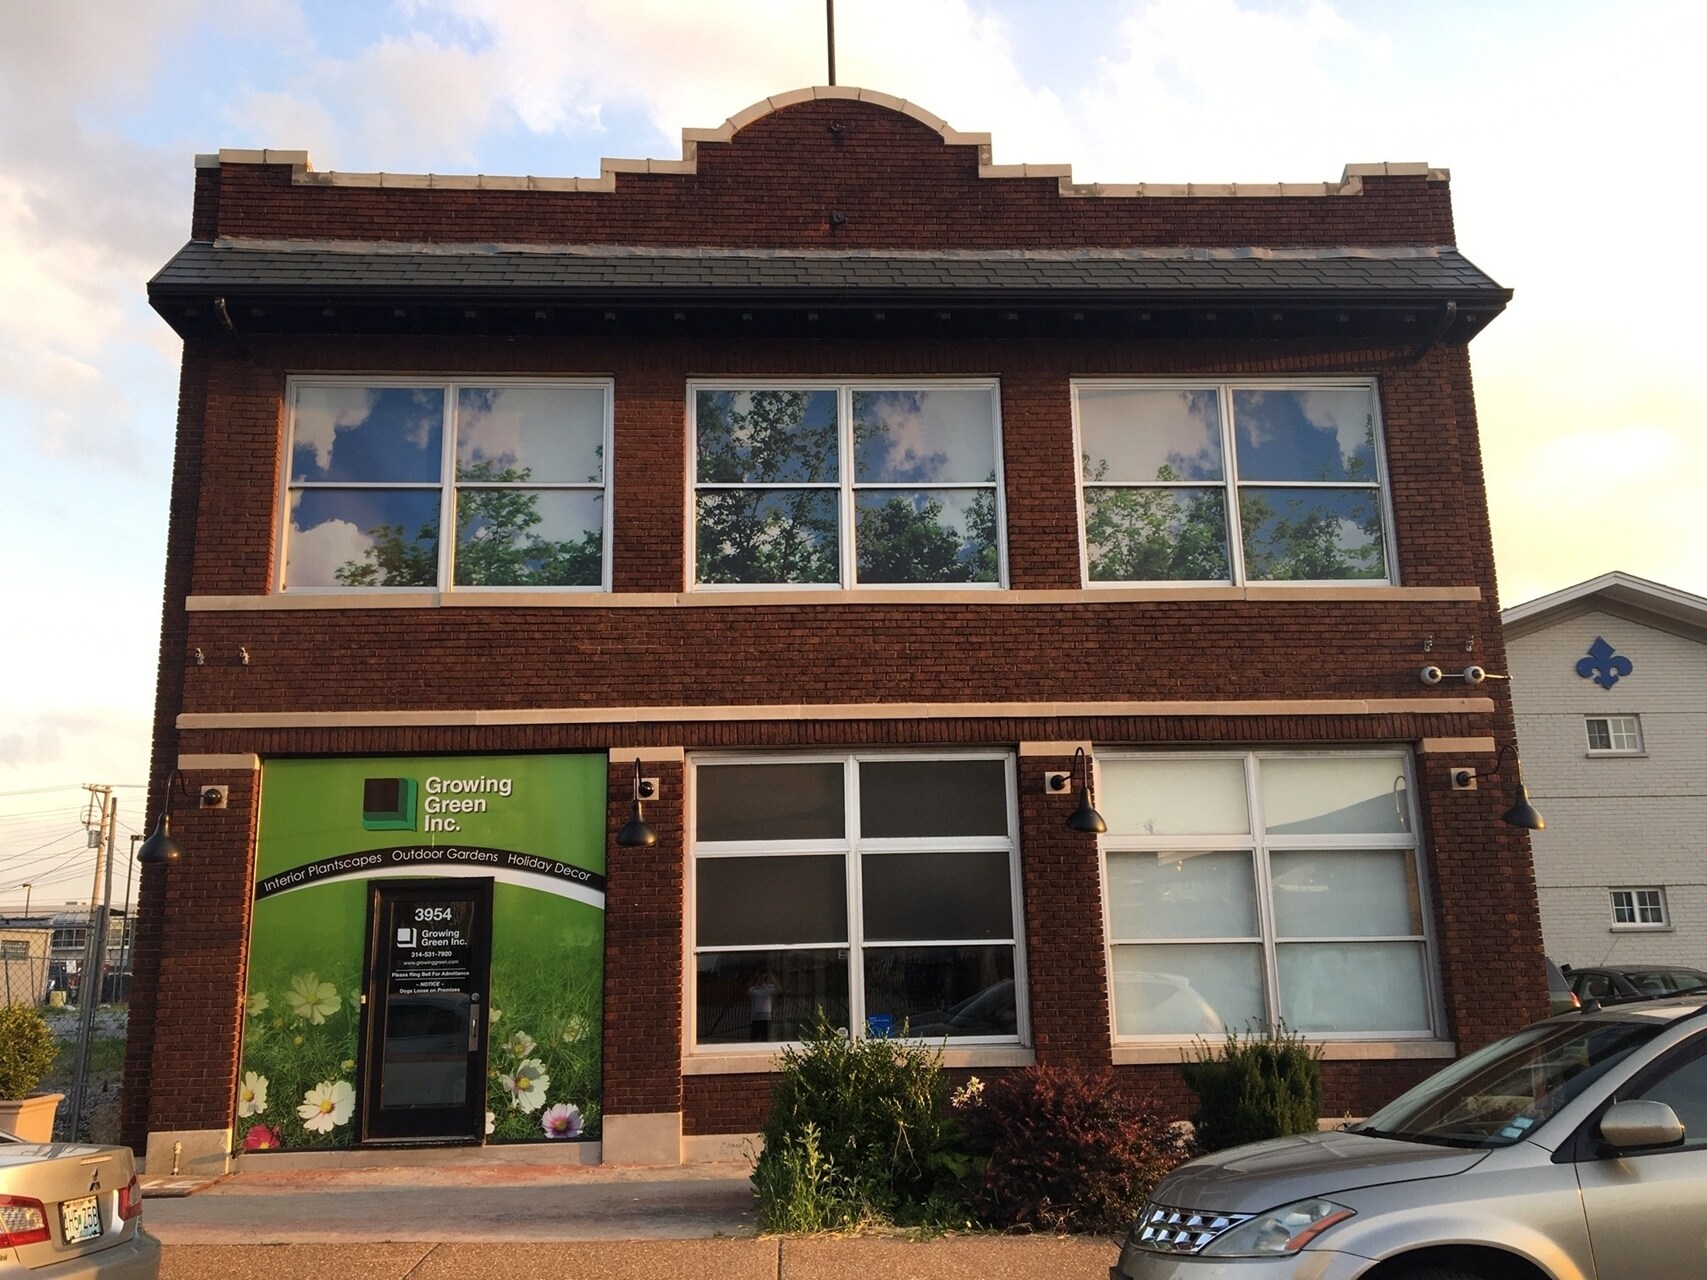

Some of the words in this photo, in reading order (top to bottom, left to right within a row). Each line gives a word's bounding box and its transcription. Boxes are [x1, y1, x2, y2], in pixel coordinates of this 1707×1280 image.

[425, 776, 512, 797] Growing
[425, 795, 487, 814] Green
[425, 814, 461, 833] Inc.
[264, 871, 306, 892] Interior
[308, 852, 382, 878] Plantscapes
[391, 848, 444, 862] Outdoor
[447, 848, 499, 863] Gardens
[507, 853, 553, 873] Holiday
[554, 862, 591, 881] Decor
[415, 908, 452, 921] 3954
[421, 938, 449, 947] Green
[450, 938, 468, 946] Inc.
[422, 930, 460, 938] Growing
